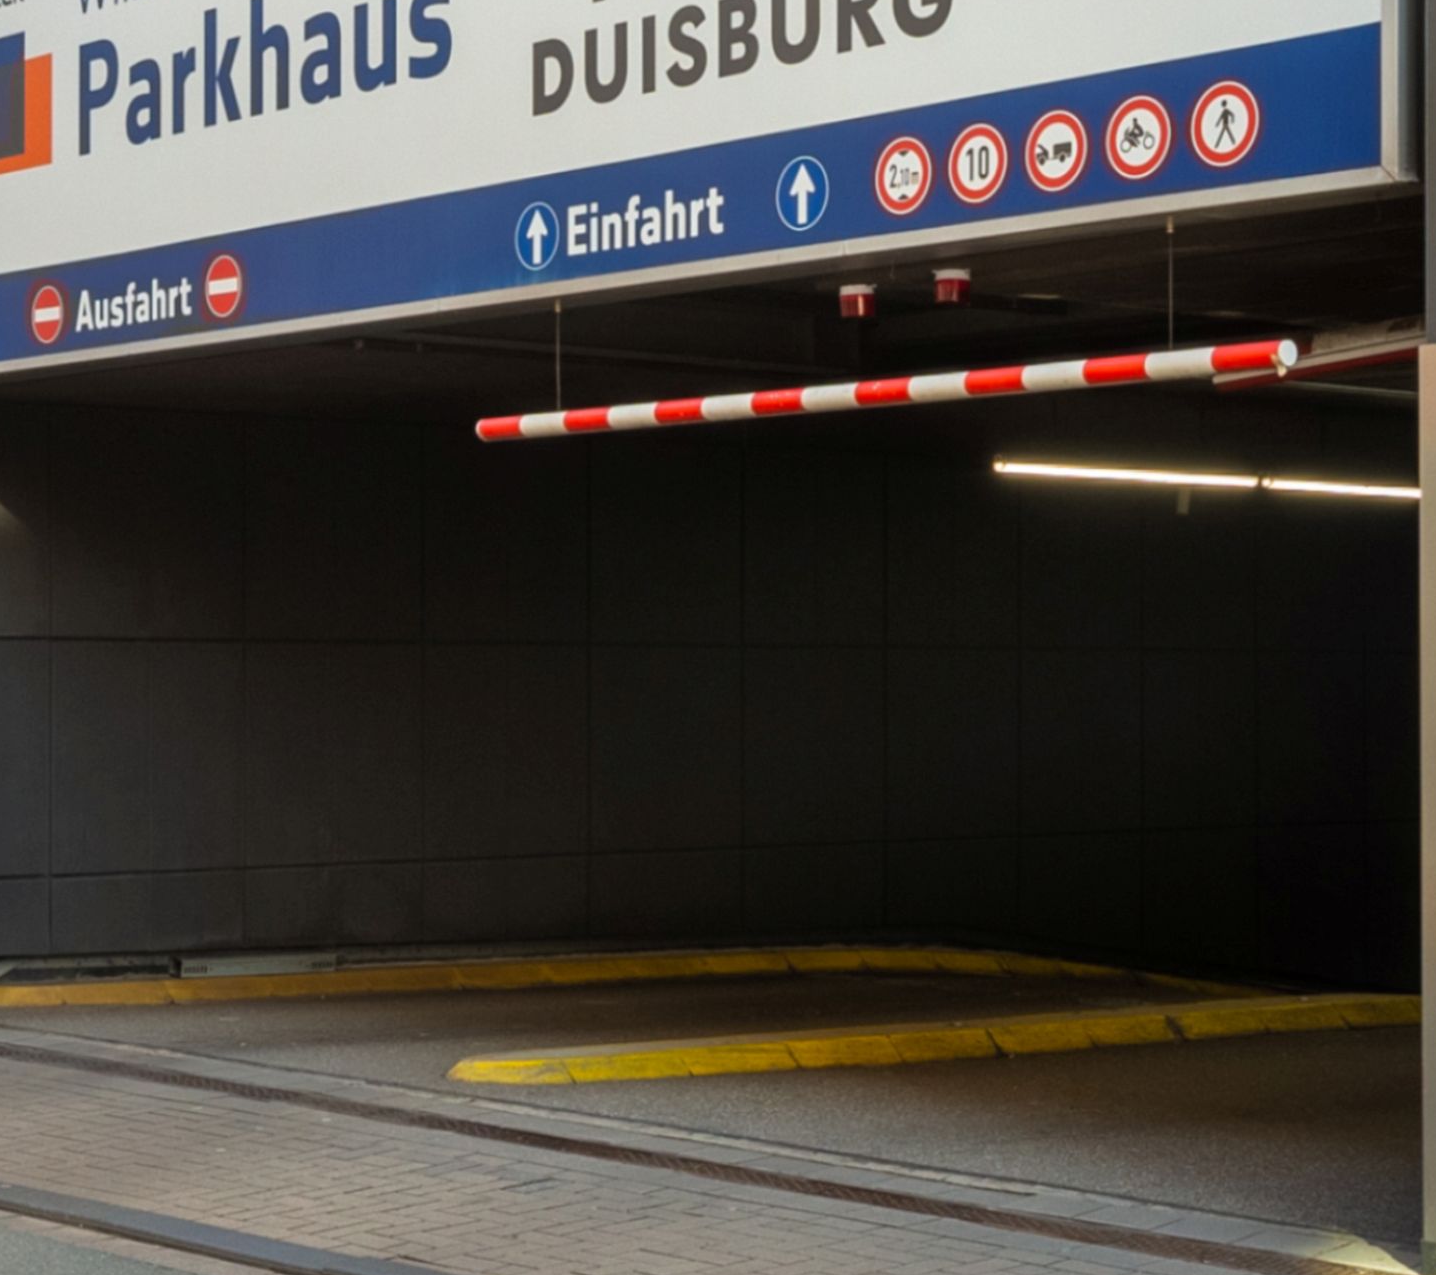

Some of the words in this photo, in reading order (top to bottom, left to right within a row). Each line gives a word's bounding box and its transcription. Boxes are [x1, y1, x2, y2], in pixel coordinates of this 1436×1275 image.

[966, 146, 990, 182] 10
[567, 187, 725, 257] Einfahrt
[75, 277, 192, 333] Ausfahrt
